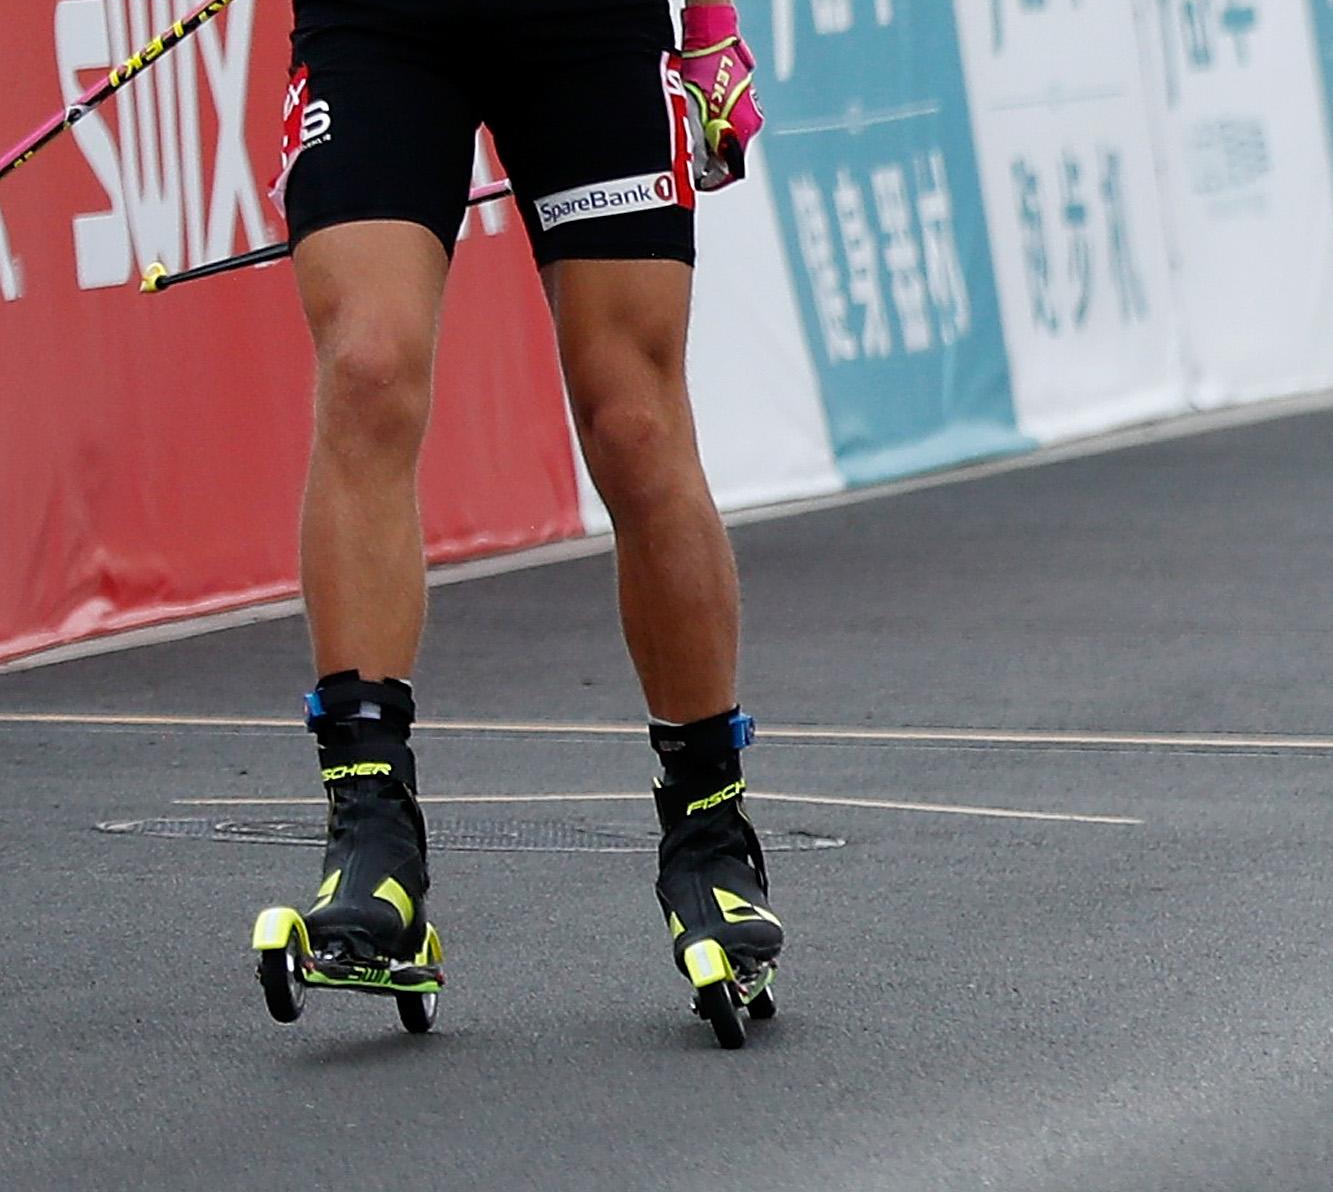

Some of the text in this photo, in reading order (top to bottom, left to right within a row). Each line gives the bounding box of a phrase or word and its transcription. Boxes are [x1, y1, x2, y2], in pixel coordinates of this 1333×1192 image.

[708, 54, 734, 114] LEKI
[543, 178, 670, 223] SpareBank 1
